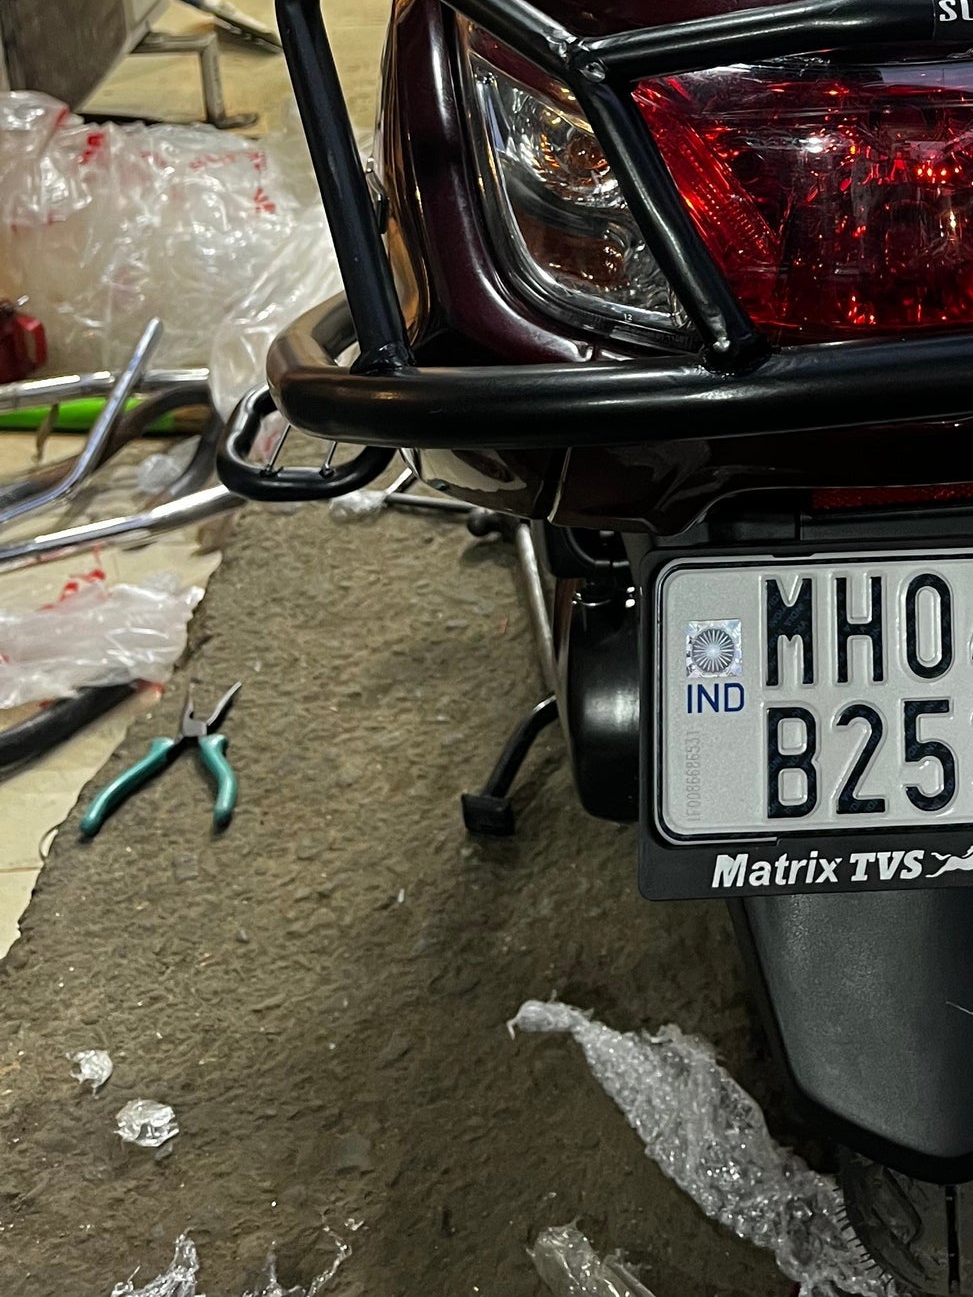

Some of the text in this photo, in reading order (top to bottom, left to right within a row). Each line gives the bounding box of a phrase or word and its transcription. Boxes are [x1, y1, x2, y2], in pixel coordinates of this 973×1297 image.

[686, 682, 745, 714] IND
[711, 850, 844, 888] Matrix
[849, 848, 925, 881] TVS
